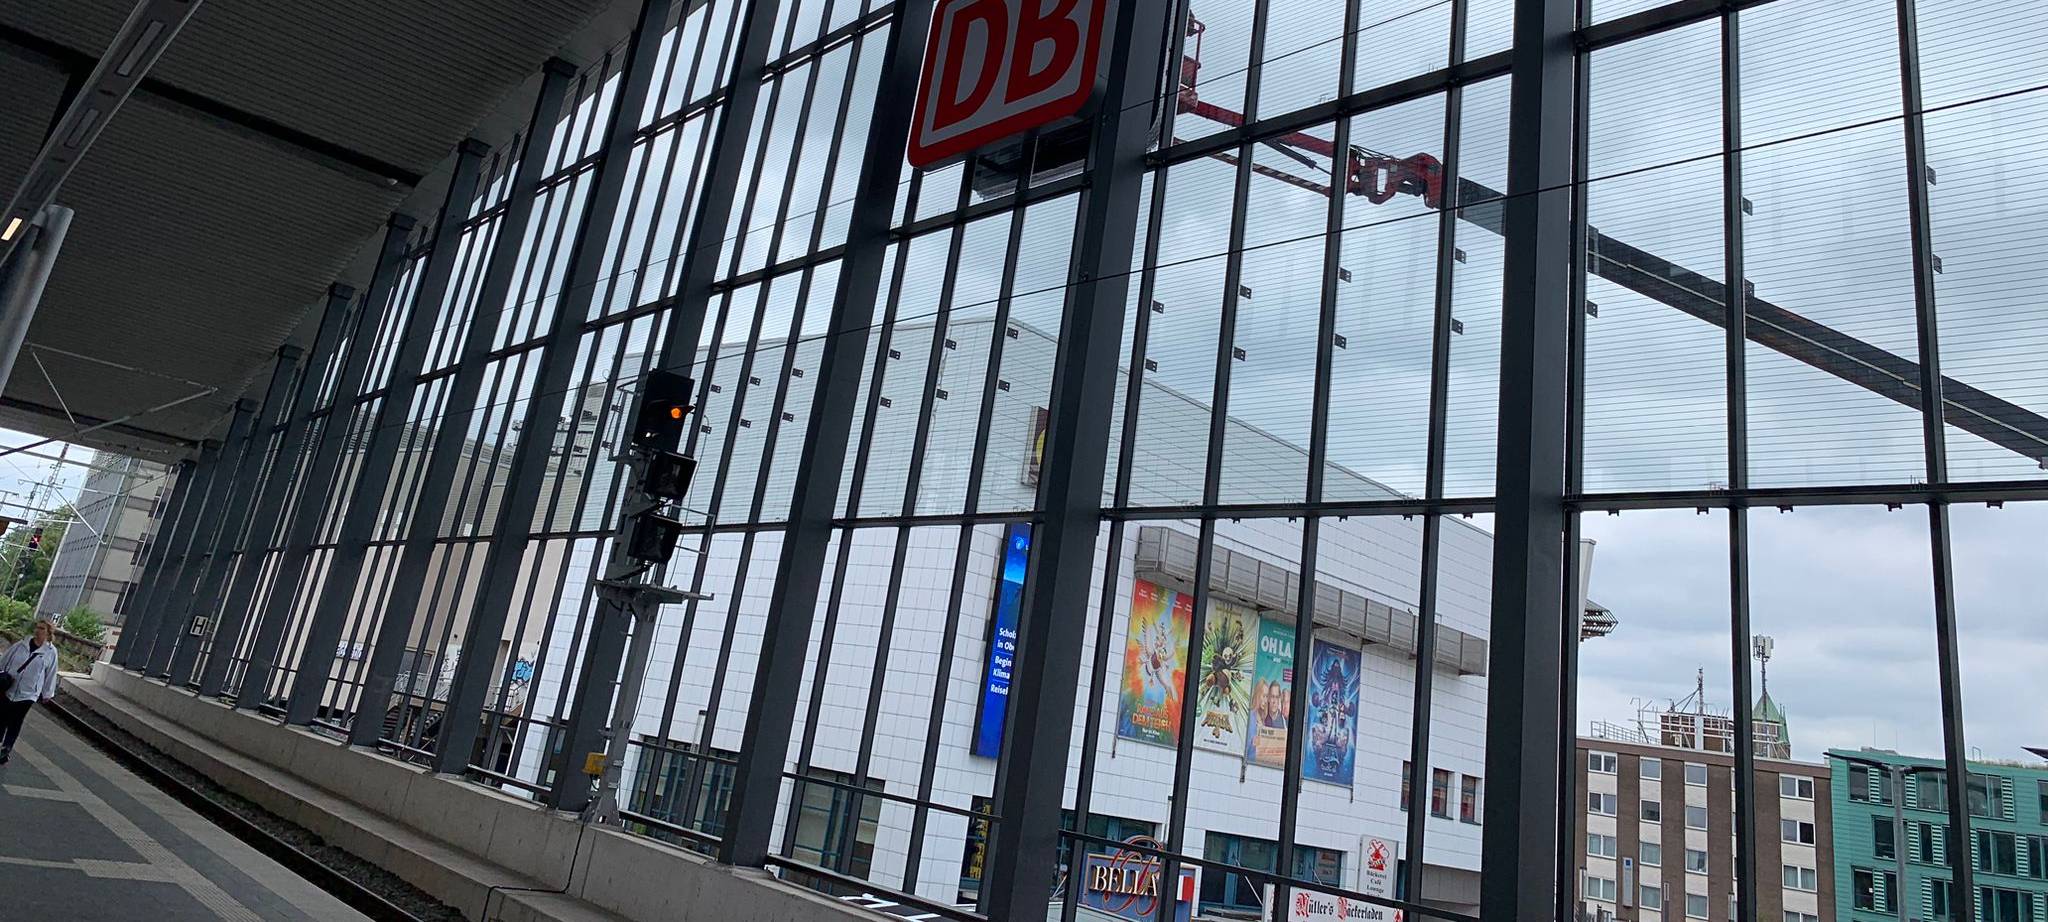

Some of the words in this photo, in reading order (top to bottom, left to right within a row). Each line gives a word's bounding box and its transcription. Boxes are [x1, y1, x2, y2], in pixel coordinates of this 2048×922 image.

[932, 0, 1080, 132] DB
[1093, 865, 1159, 897] BELLA
[1296, 892, 1334, 917] Müller's
